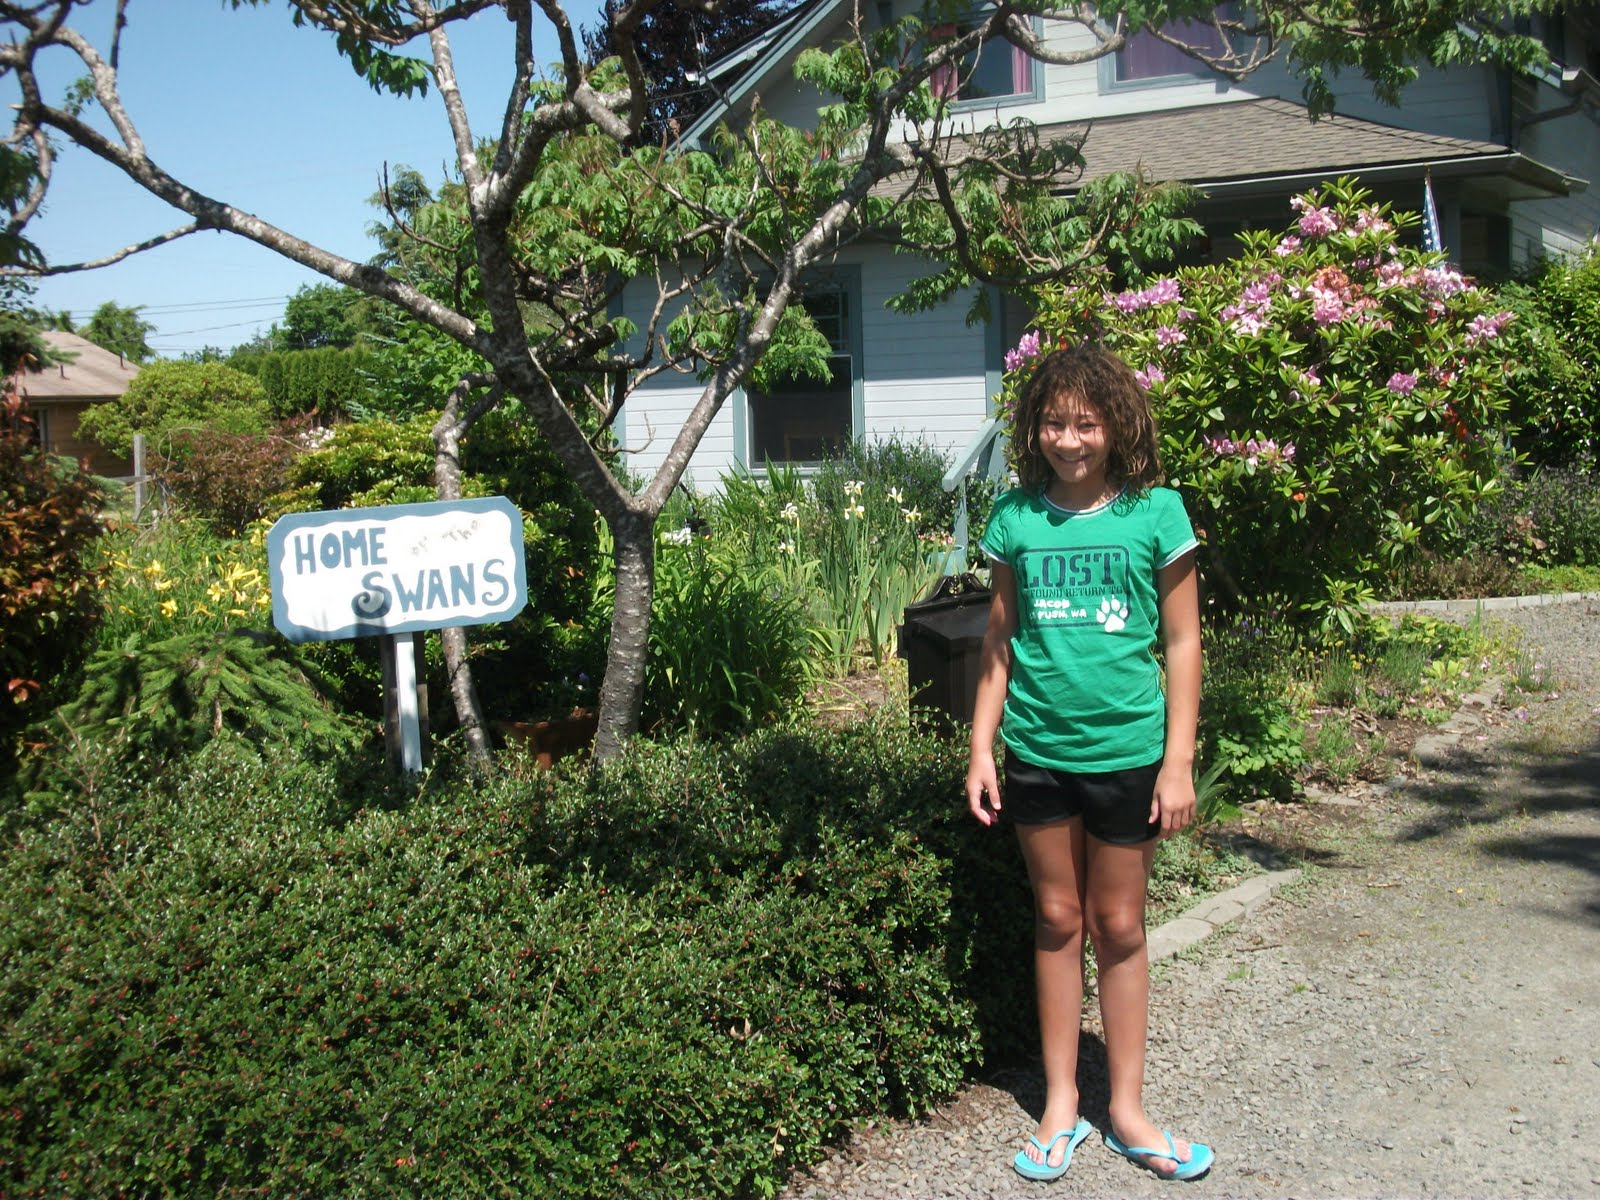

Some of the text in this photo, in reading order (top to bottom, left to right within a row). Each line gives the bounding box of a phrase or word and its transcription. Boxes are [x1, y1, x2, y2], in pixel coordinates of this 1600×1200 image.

[294, 527, 387, 575] HOME
[1018, 552, 1122, 588] LOST
[352, 558, 510, 619] SWANS
[1030, 588, 1063, 599] FOUND
[1065, 586, 1106, 598] RETURN
[1034, 598, 1071, 609] JACOB
[1070, 608, 1087, 618] WA
